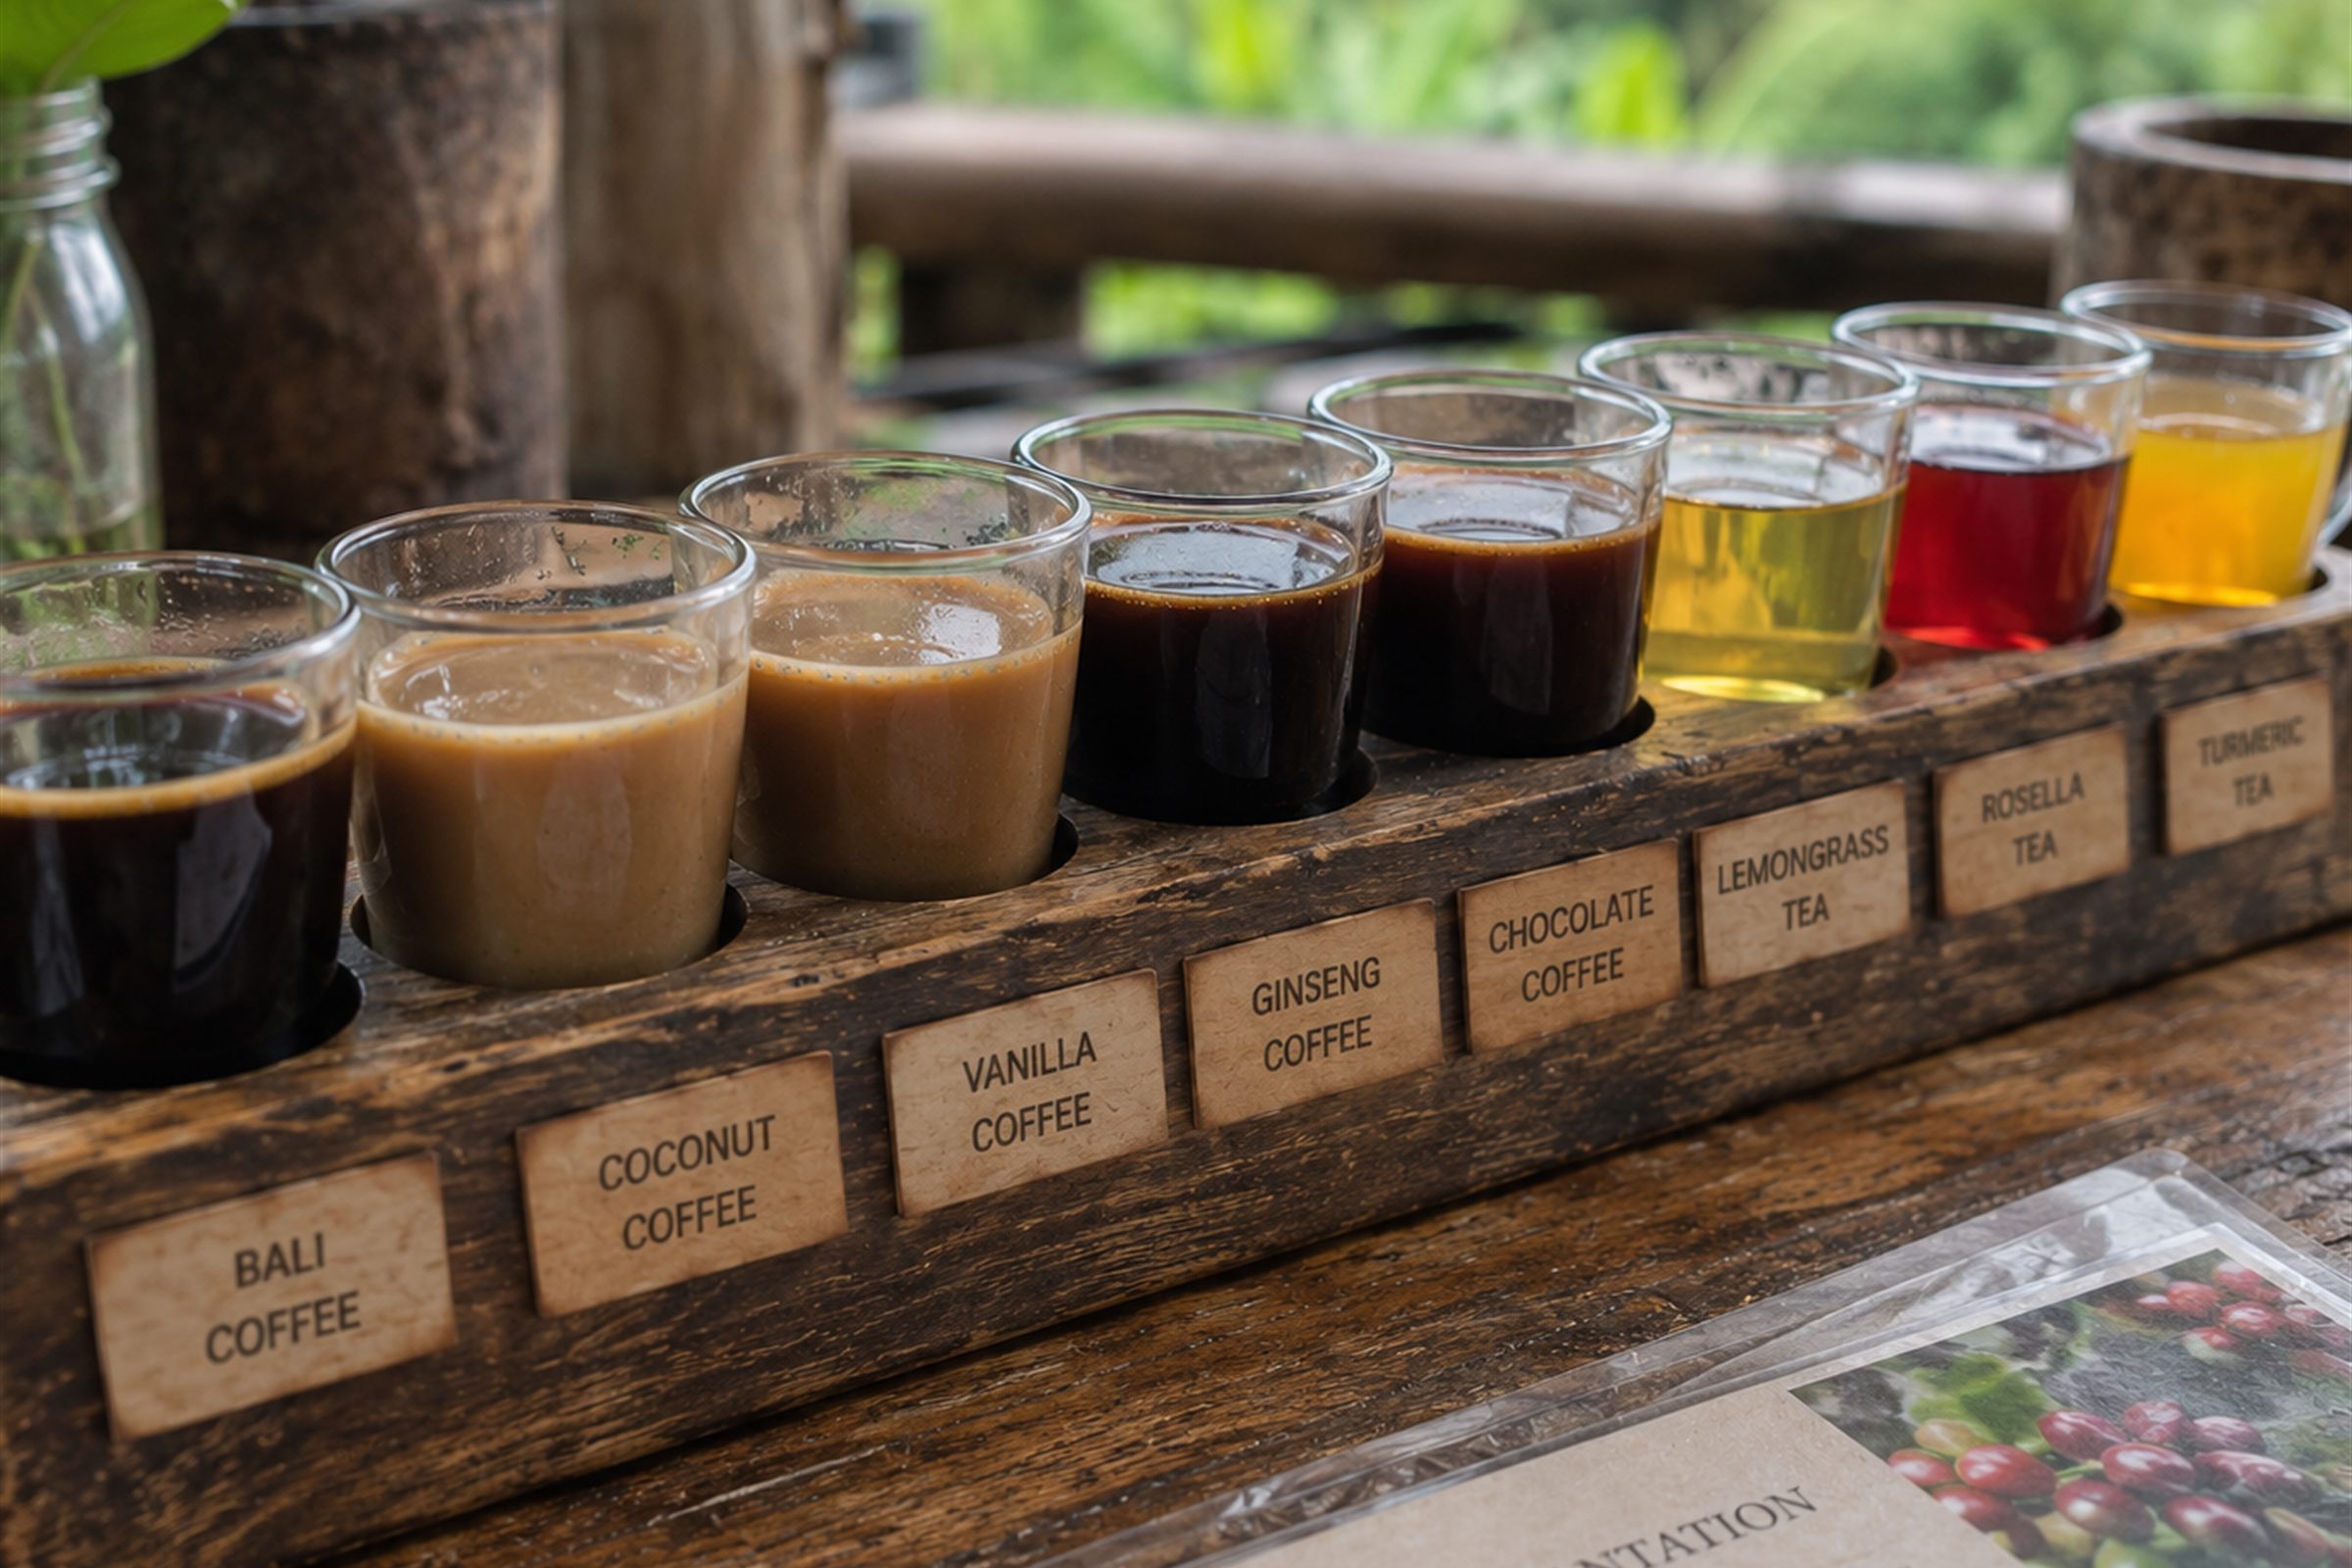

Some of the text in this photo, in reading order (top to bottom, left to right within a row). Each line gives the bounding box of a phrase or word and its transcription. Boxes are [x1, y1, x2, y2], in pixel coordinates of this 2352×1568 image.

[2198, 715, 2304, 765] TURMERIC
[1982, 773, 2084, 823] ROSELLA
[2233, 774, 2274, 807] TEA
[1718, 825, 1888, 895] LEMONGRASS
[2013, 831, 2057, 865] TEA
[1490, 885, 1653, 954] CHOCOLATE
[1783, 894, 1829, 930] TEA
[1252, 957, 1380, 1015] GINSENG
[1522, 948, 1623, 1002] COFFEE
[963, 1032, 1097, 1092] VANILLA
[1264, 1015, 1372, 1071] COFFEE
[973, 1092, 1092, 1152] COFFEE
[599, 1115, 775, 1191] COCONUT
[622, 1185, 757, 1250] COFFEE
[235, 1233, 323, 1288] BALI
[206, 1291, 361, 1363] COFFEE
